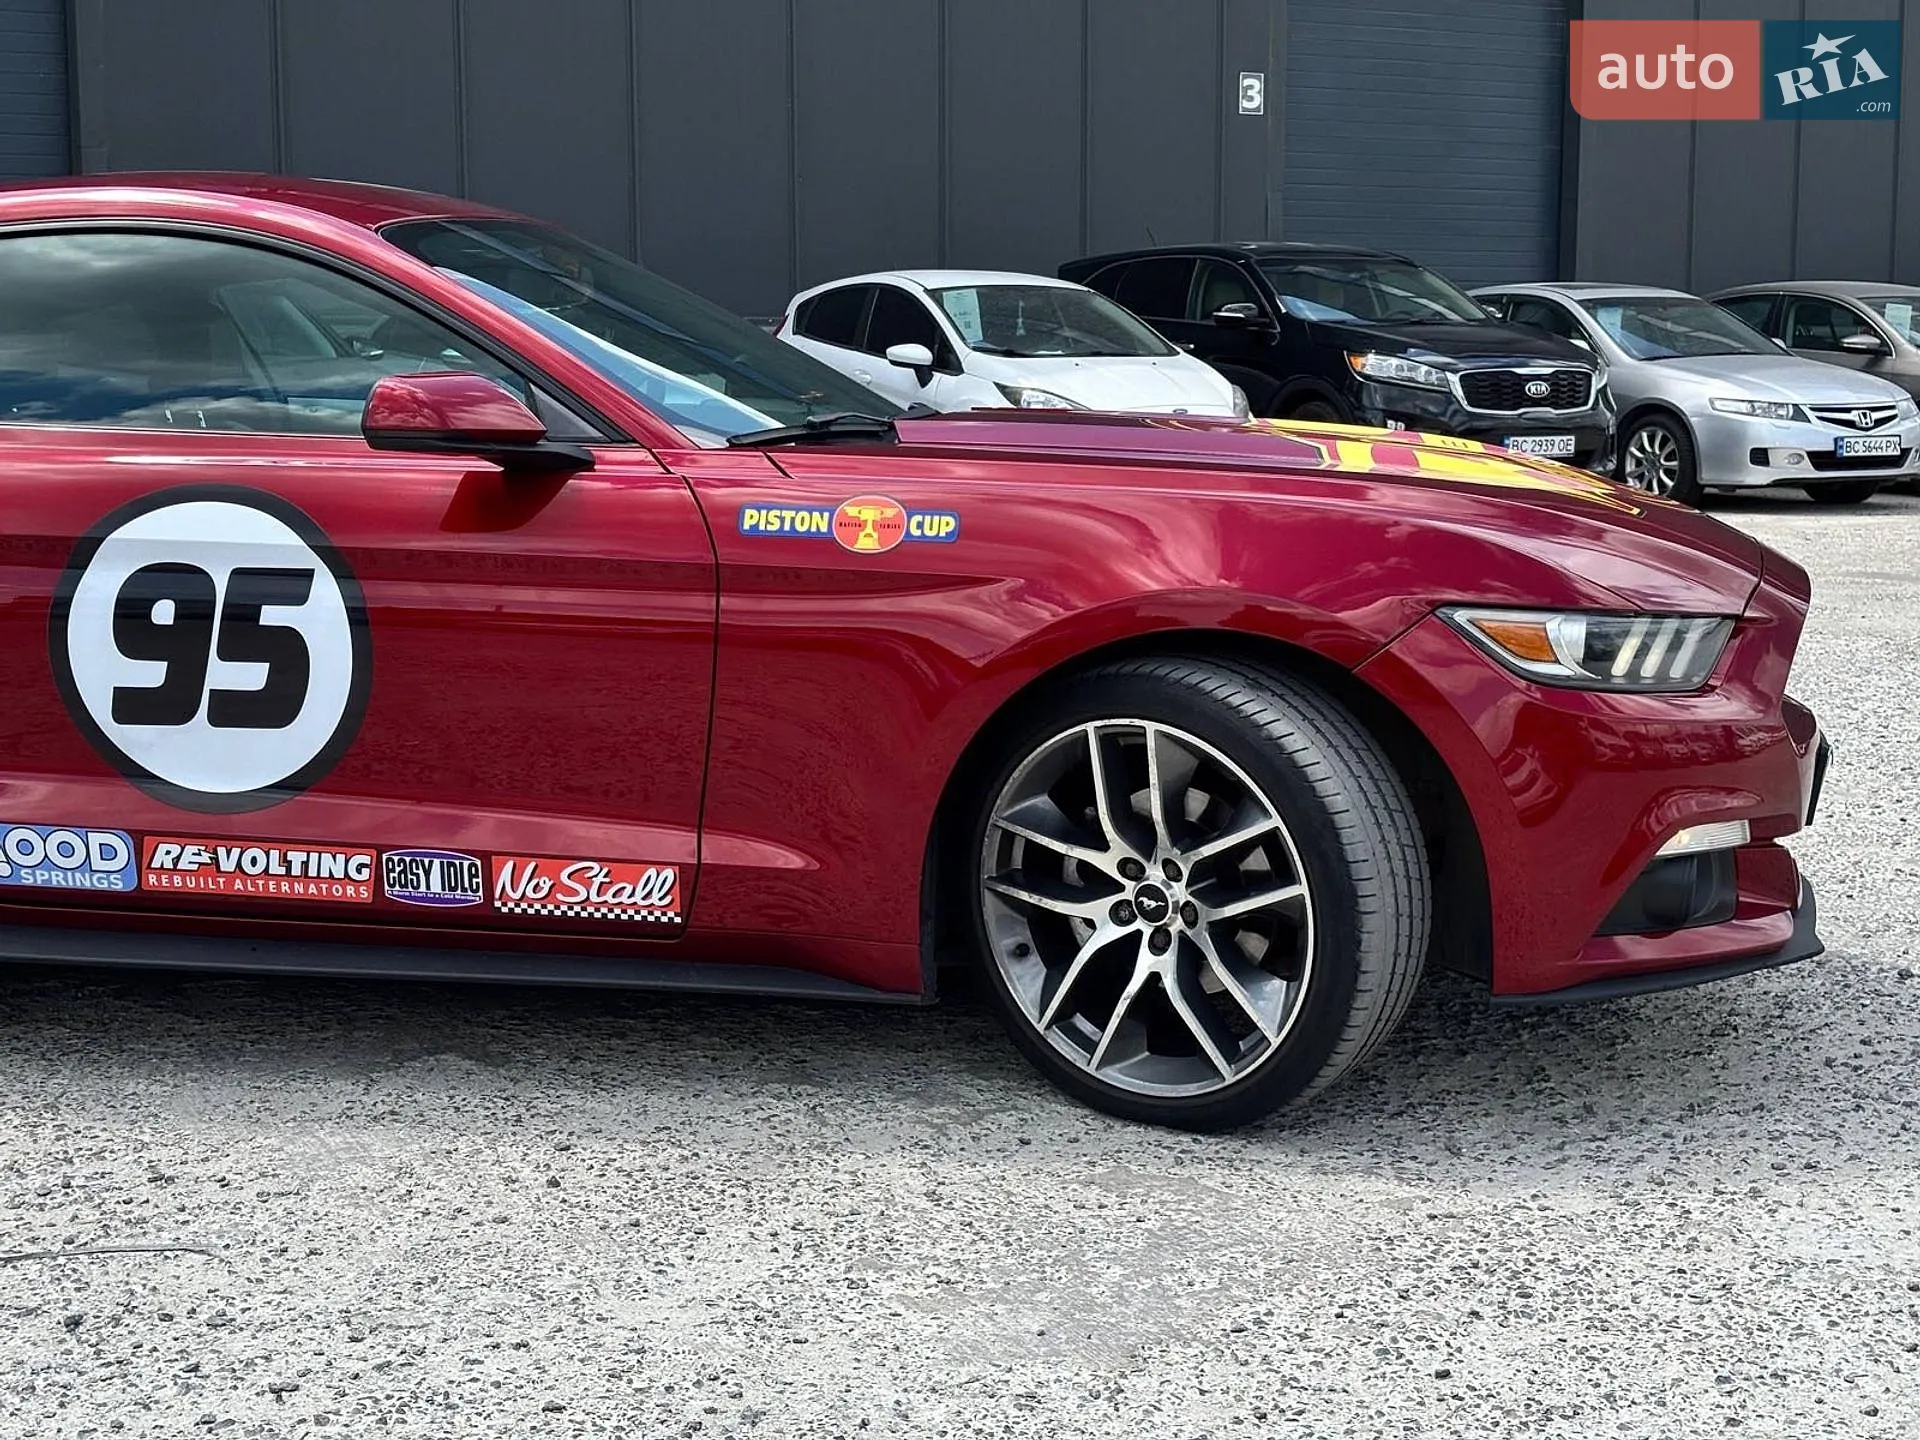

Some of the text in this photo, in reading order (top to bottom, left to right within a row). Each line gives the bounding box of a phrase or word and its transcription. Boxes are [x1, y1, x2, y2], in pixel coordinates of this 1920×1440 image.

[1242, 78, 1261, 109] 3
[1530, 384, 1548, 395] KIA
[1511, 438, 1573, 453] BC 2939 OE
[1845, 440, 1899, 454] BC 5644 PX
[742, 508, 956, 537] PISTON CUP
[111, 561, 316, 730] 95
[0, 826, 131, 878] OOD
[20, 869, 124, 889] SPRINGS
[148, 873, 369, 899] REBUILT ALTERNATORS
[494, 859, 676, 906] No Stall
